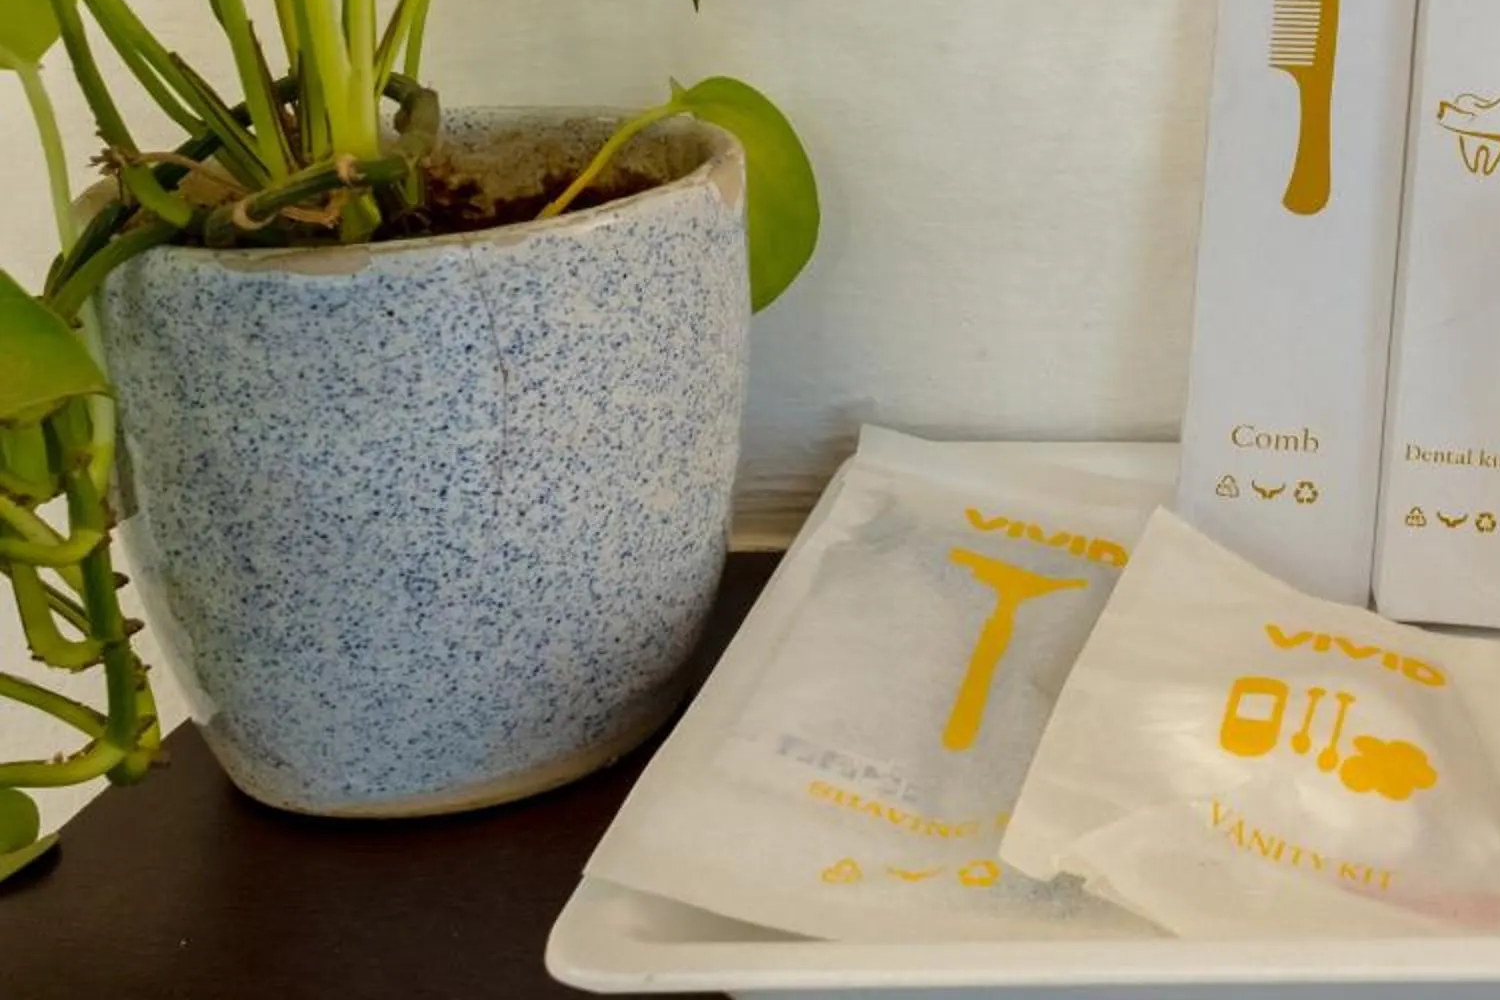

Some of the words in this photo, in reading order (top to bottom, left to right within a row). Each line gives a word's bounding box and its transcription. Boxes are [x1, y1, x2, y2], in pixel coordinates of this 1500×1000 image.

[1231, 424, 1320, 453] Comb
[1405, 444, 1473, 466] Dental
[964, 508, 1128, 568] VIVID
[1264, 623, 1446, 687] VIVID
[810, 780, 981, 838] SHAVING
[1211, 796, 1328, 871] VANITY
[1338, 861, 1394, 889] KIT
